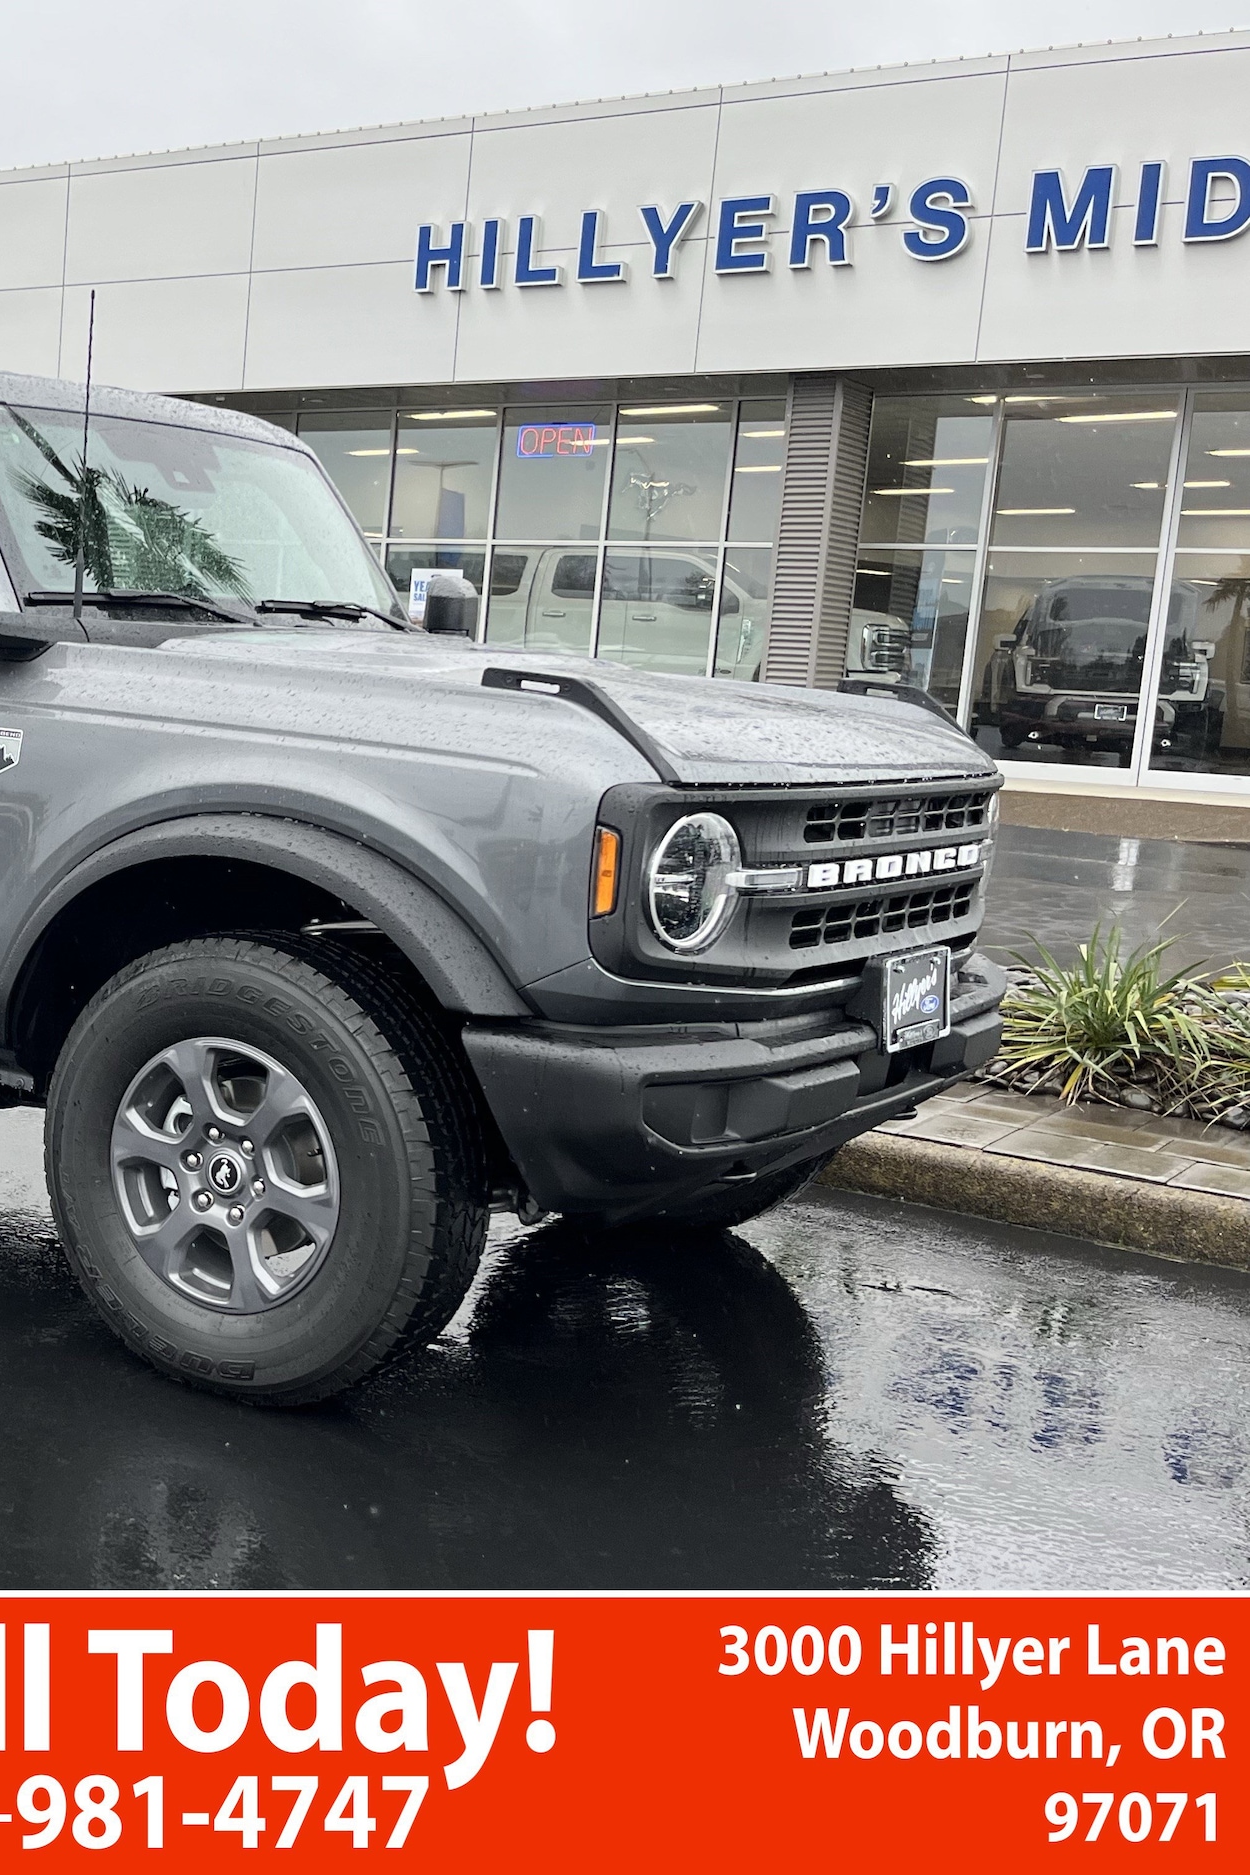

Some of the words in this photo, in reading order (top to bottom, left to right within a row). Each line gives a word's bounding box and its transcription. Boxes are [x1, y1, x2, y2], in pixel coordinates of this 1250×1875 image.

[1025, 155, 1250, 253] MID
[520, 427, 593, 455] OPEN
[807, 844, 980, 889] BRONCO
[135, 976, 386, 1147] BRIDGESTONE
[75, 1244, 257, 1381] DUELER
